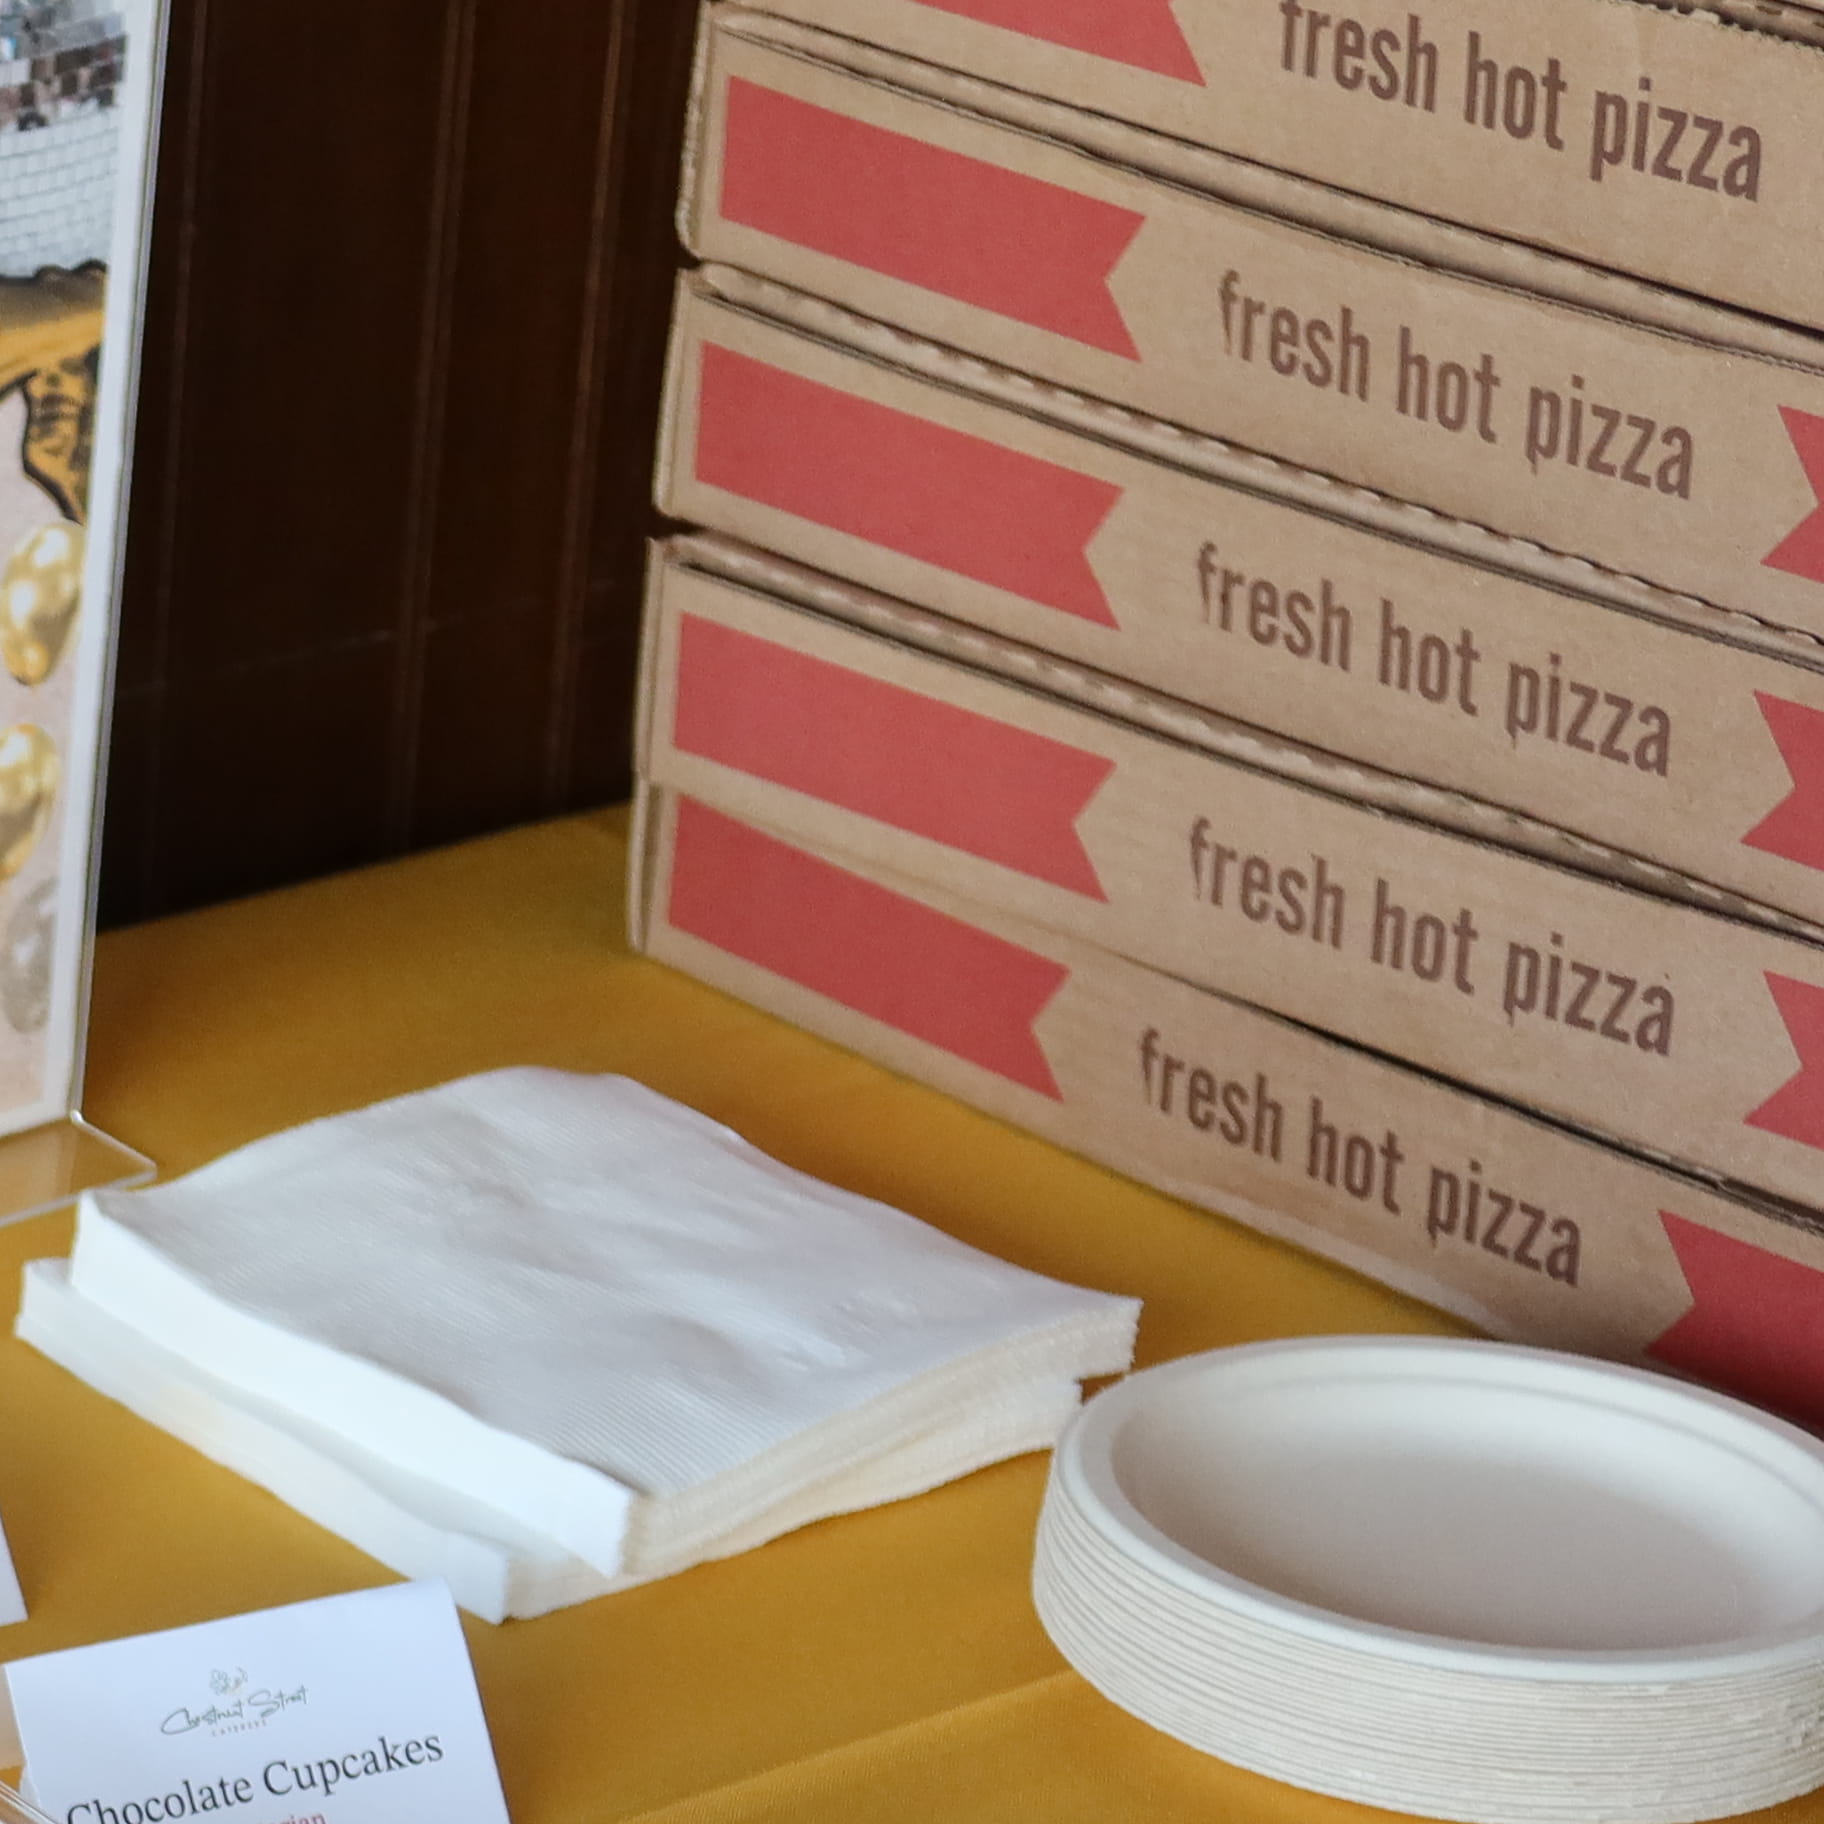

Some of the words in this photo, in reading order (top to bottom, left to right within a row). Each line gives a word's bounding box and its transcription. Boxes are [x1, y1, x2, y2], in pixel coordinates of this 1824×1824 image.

[1280, 0, 1440, 112] fresh
[1464, 31, 1567, 152] hot
[1590, 77, 1763, 202] pizza
[1218, 268, 1373, 403] fresh
[1396, 326, 1502, 444] hot
[1525, 376, 1695, 501] pizza
[1197, 542, 1352, 672] fresh
[1378, 598, 1482, 717] hot
[1506, 653, 1673, 777] pizza
[1189, 818, 1347, 950] fresh
[1371, 878, 1479, 996] hot
[1503, 935, 1676, 1057] pizza
[1139, 1027, 1285, 1162] fresh
[1307, 1097, 1405, 1216] hot
[1427, 1161, 1583, 1288] pizza
[263, 1733, 444, 1798] Cupcakes
